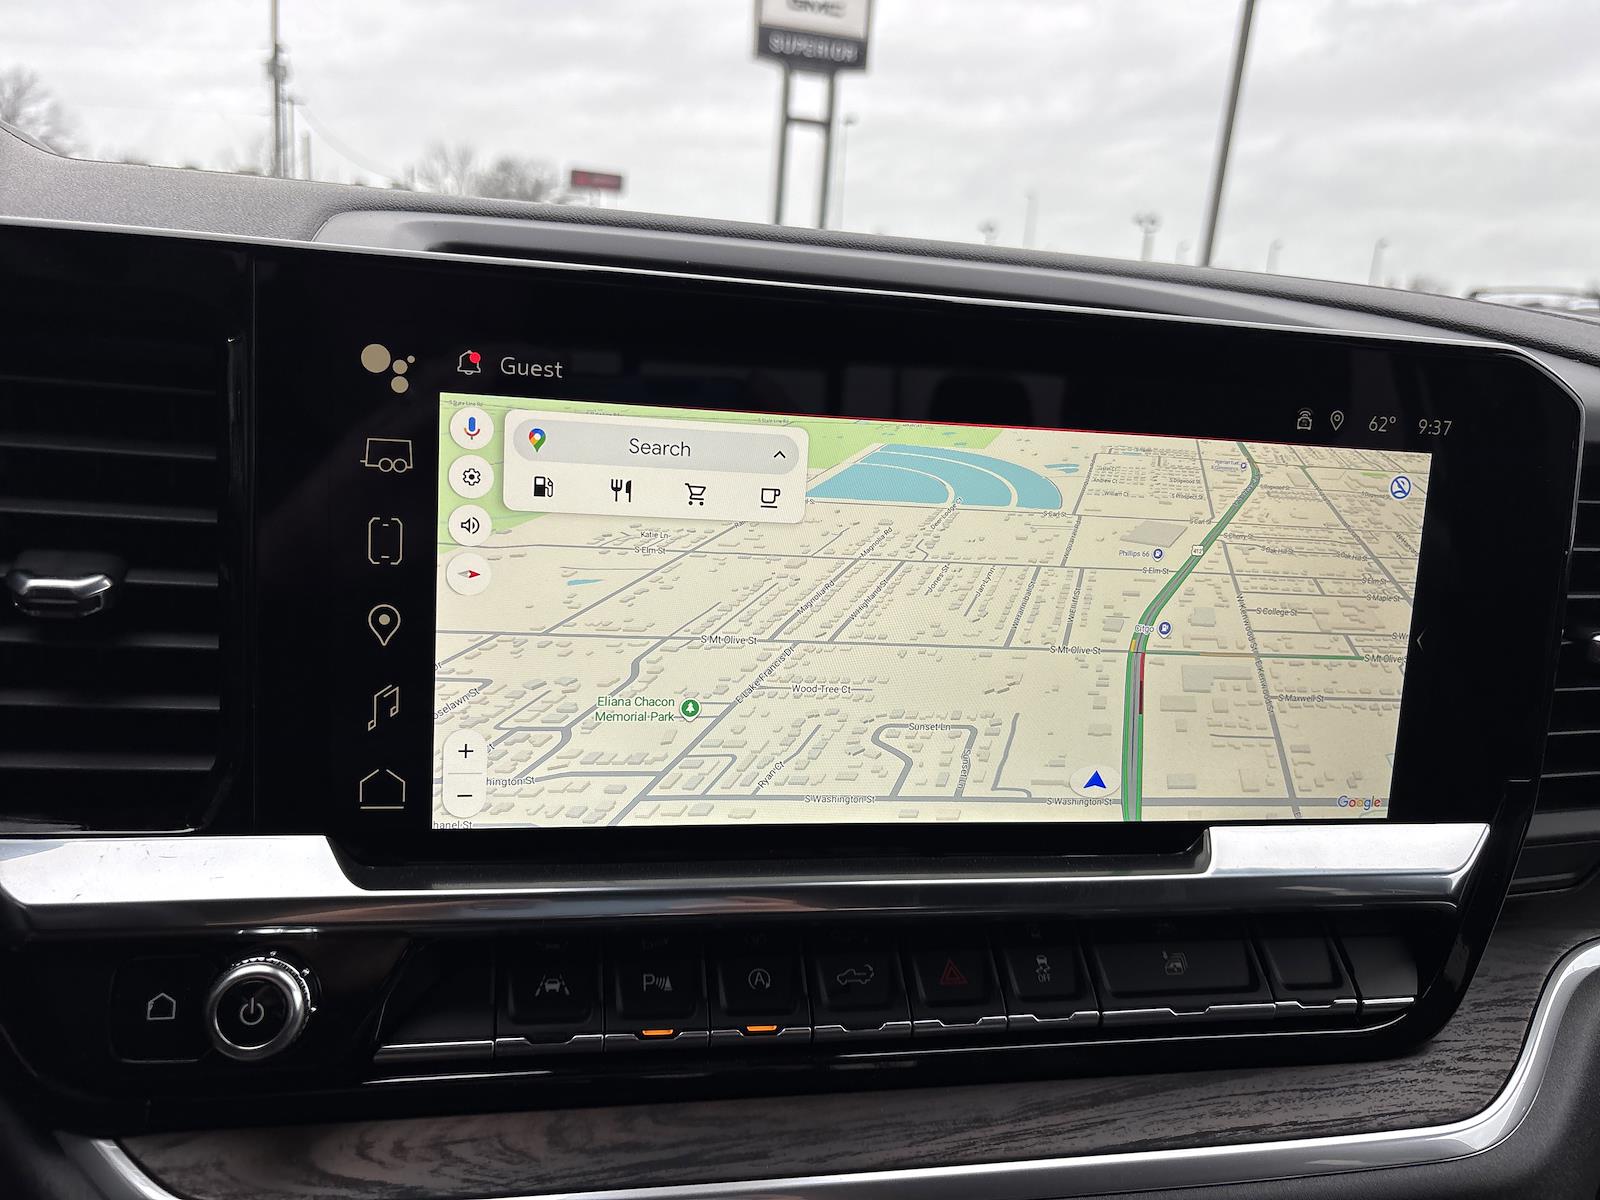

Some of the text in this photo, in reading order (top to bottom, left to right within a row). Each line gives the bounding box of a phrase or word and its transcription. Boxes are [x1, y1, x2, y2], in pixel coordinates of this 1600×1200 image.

[769, 31, 857, 62] SUPERIOR
[500, 356, 563, 378] Guest
[1418, 418, 1452, 436] 9:37
[628, 437, 692, 457] Search
[930, 518, 942, 530] Deer
[942, 502, 958, 520] Lodge
[860, 526, 893, 558] Magnolia Rd
[1119, 550, 1140, 558] Phillips
[928, 572, 943, 593] Jones
[976, 567, 995, 597] Jan Lynn
[798, 580, 835, 615] Magnolia Rd
[857, 586, 882, 614] Highland
[1263, 608, 1289, 617] College
[1238, 603, 1256, 641] Kenwood
[1135, 625, 1154, 634] Citgo
[701, 635, 757, 645] S Mt Olive St
[1050, 645, 1101, 655] S Mt Olive St
[1364, 654, 1370, 662] S
[1383, 655, 1401, 663] Olive
[742, 678, 760, 698] Lake
[758, 656, 786, 683] Francis
[784, 646, 795, 658] Dr
[841, 685, 851, 694] Ct
[1257, 667, 1273, 706] Kenwood
[468, 688, 480, 698] St
[597, 696, 675, 707] Eliana Chacon
[595, 712, 675, 722] Memorial Park
[909, 723, 951, 731] Sunset Ln
[960, 750, 971, 779] Sunset
[758, 761, 786, 790] Ryan Ct
[486, 777, 535, 788] hington St
[805, 795, 811, 803] S
[812, 795, 864, 805] Washington
[1047, 798, 1112, 808] S Washington St
[1338, 796, 1381, 810] Google
[463, 821, 472, 829] St
[1038, 974, 1050, 982] OFF
